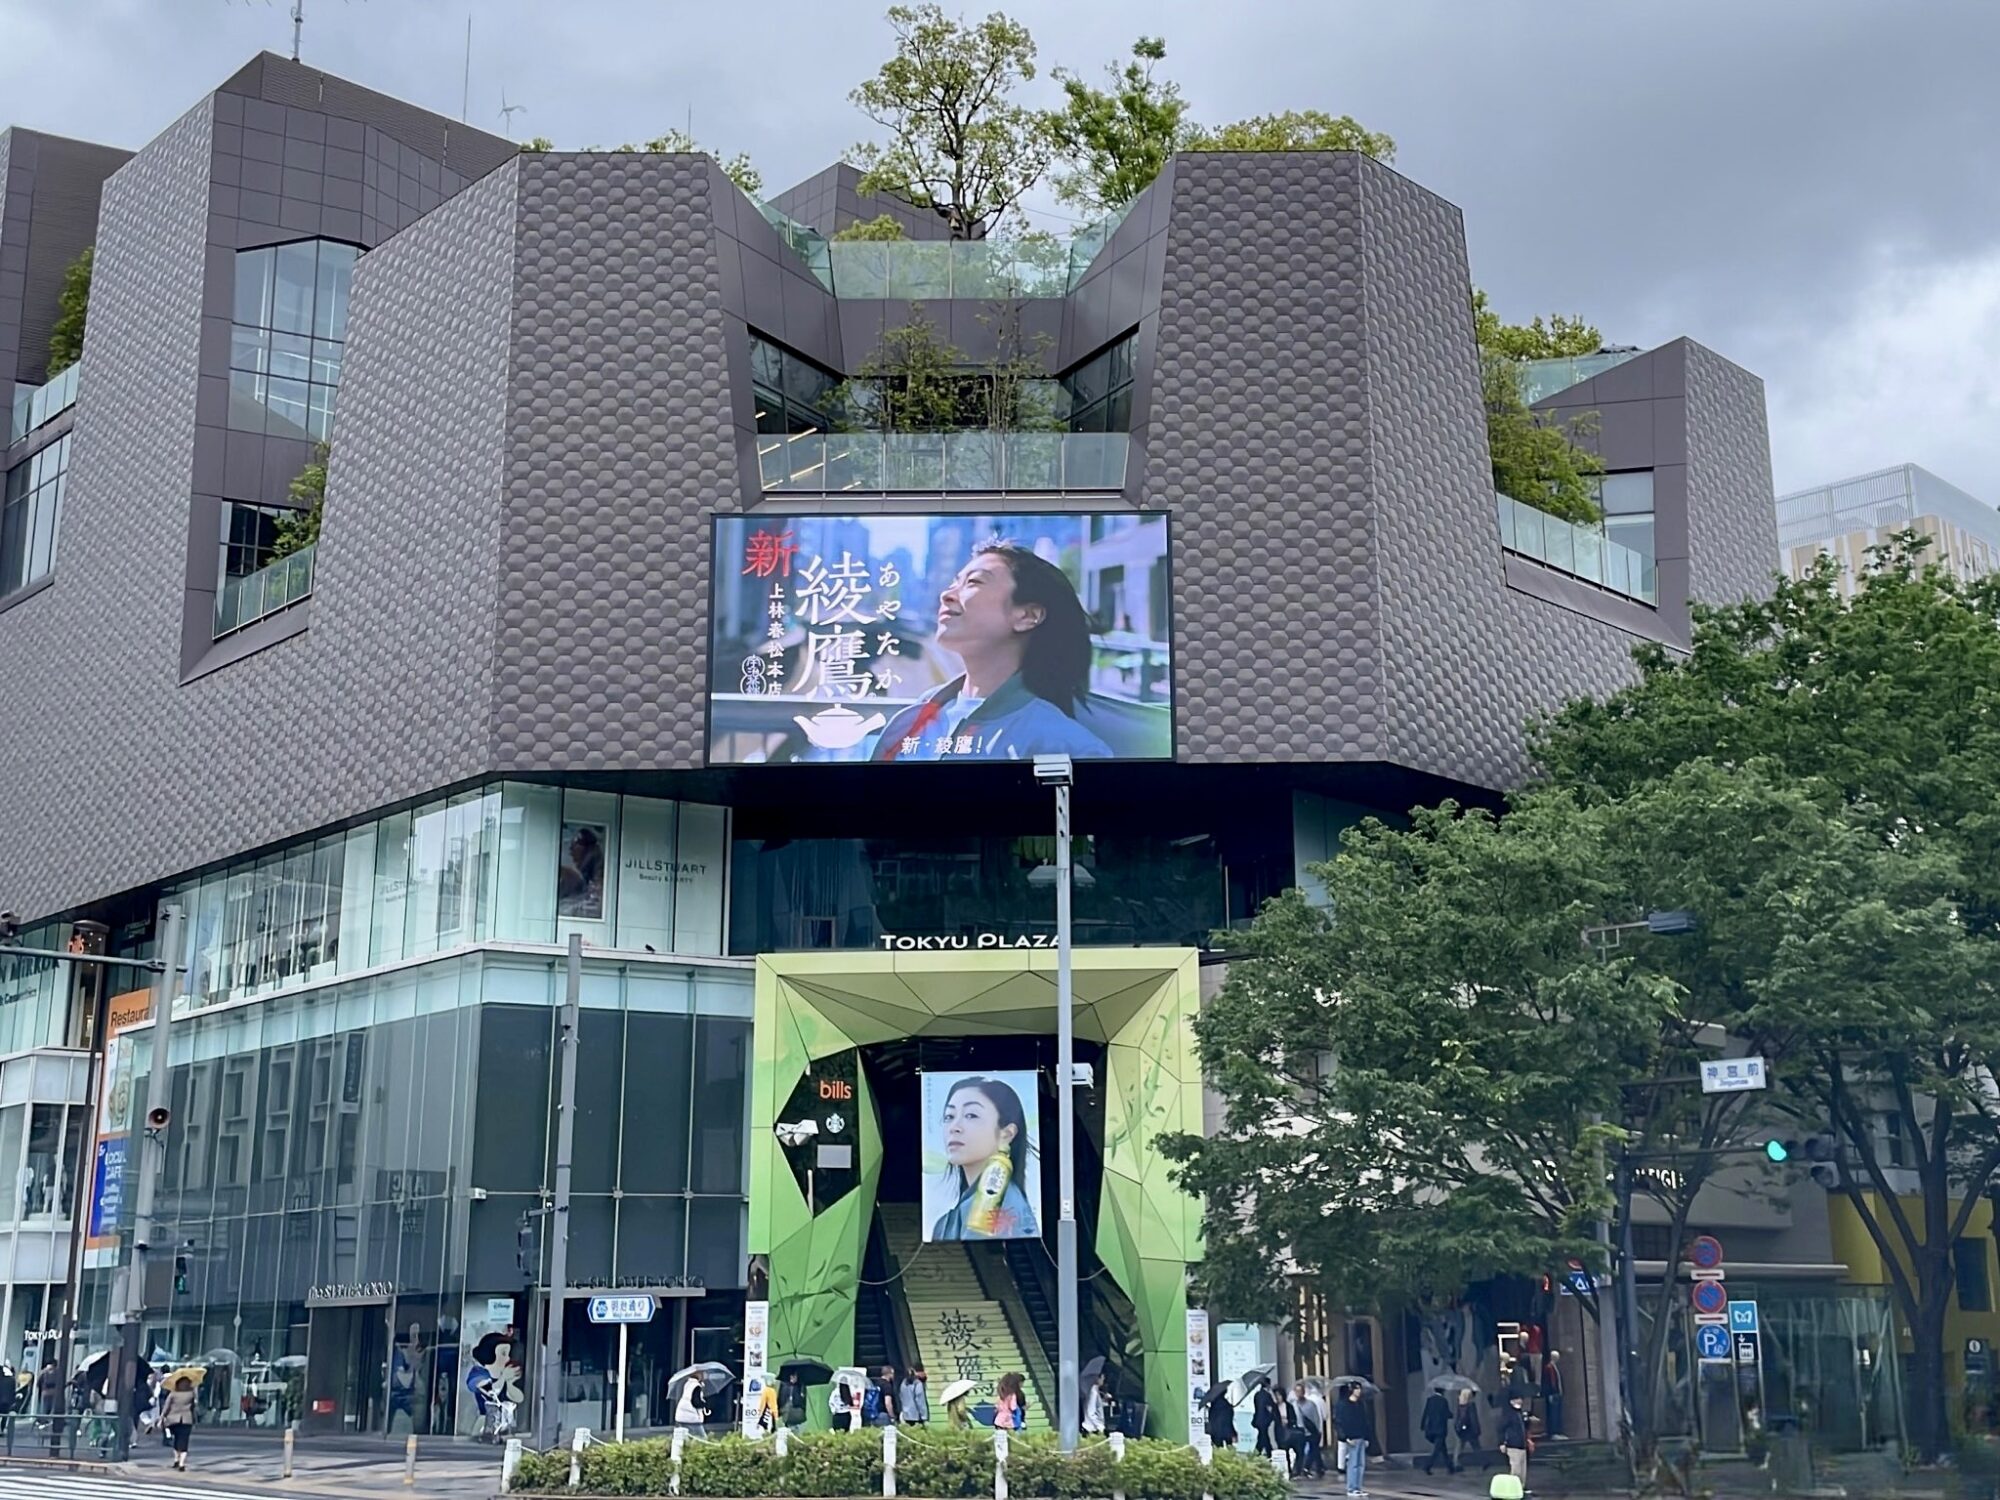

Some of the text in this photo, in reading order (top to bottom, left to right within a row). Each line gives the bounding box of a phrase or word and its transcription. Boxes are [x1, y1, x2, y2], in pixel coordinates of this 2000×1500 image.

[742, 529, 799, 577] 新
[767, 582, 785, 697] 上林春松本店
[792, 551, 877, 700] 綾鷹
[875, 562, 902, 690] あやたか
[880, 934, 969, 950] TOKYU
[820, 1080, 852, 1099] bills
[1703, 1333, 1717, 1354] P
